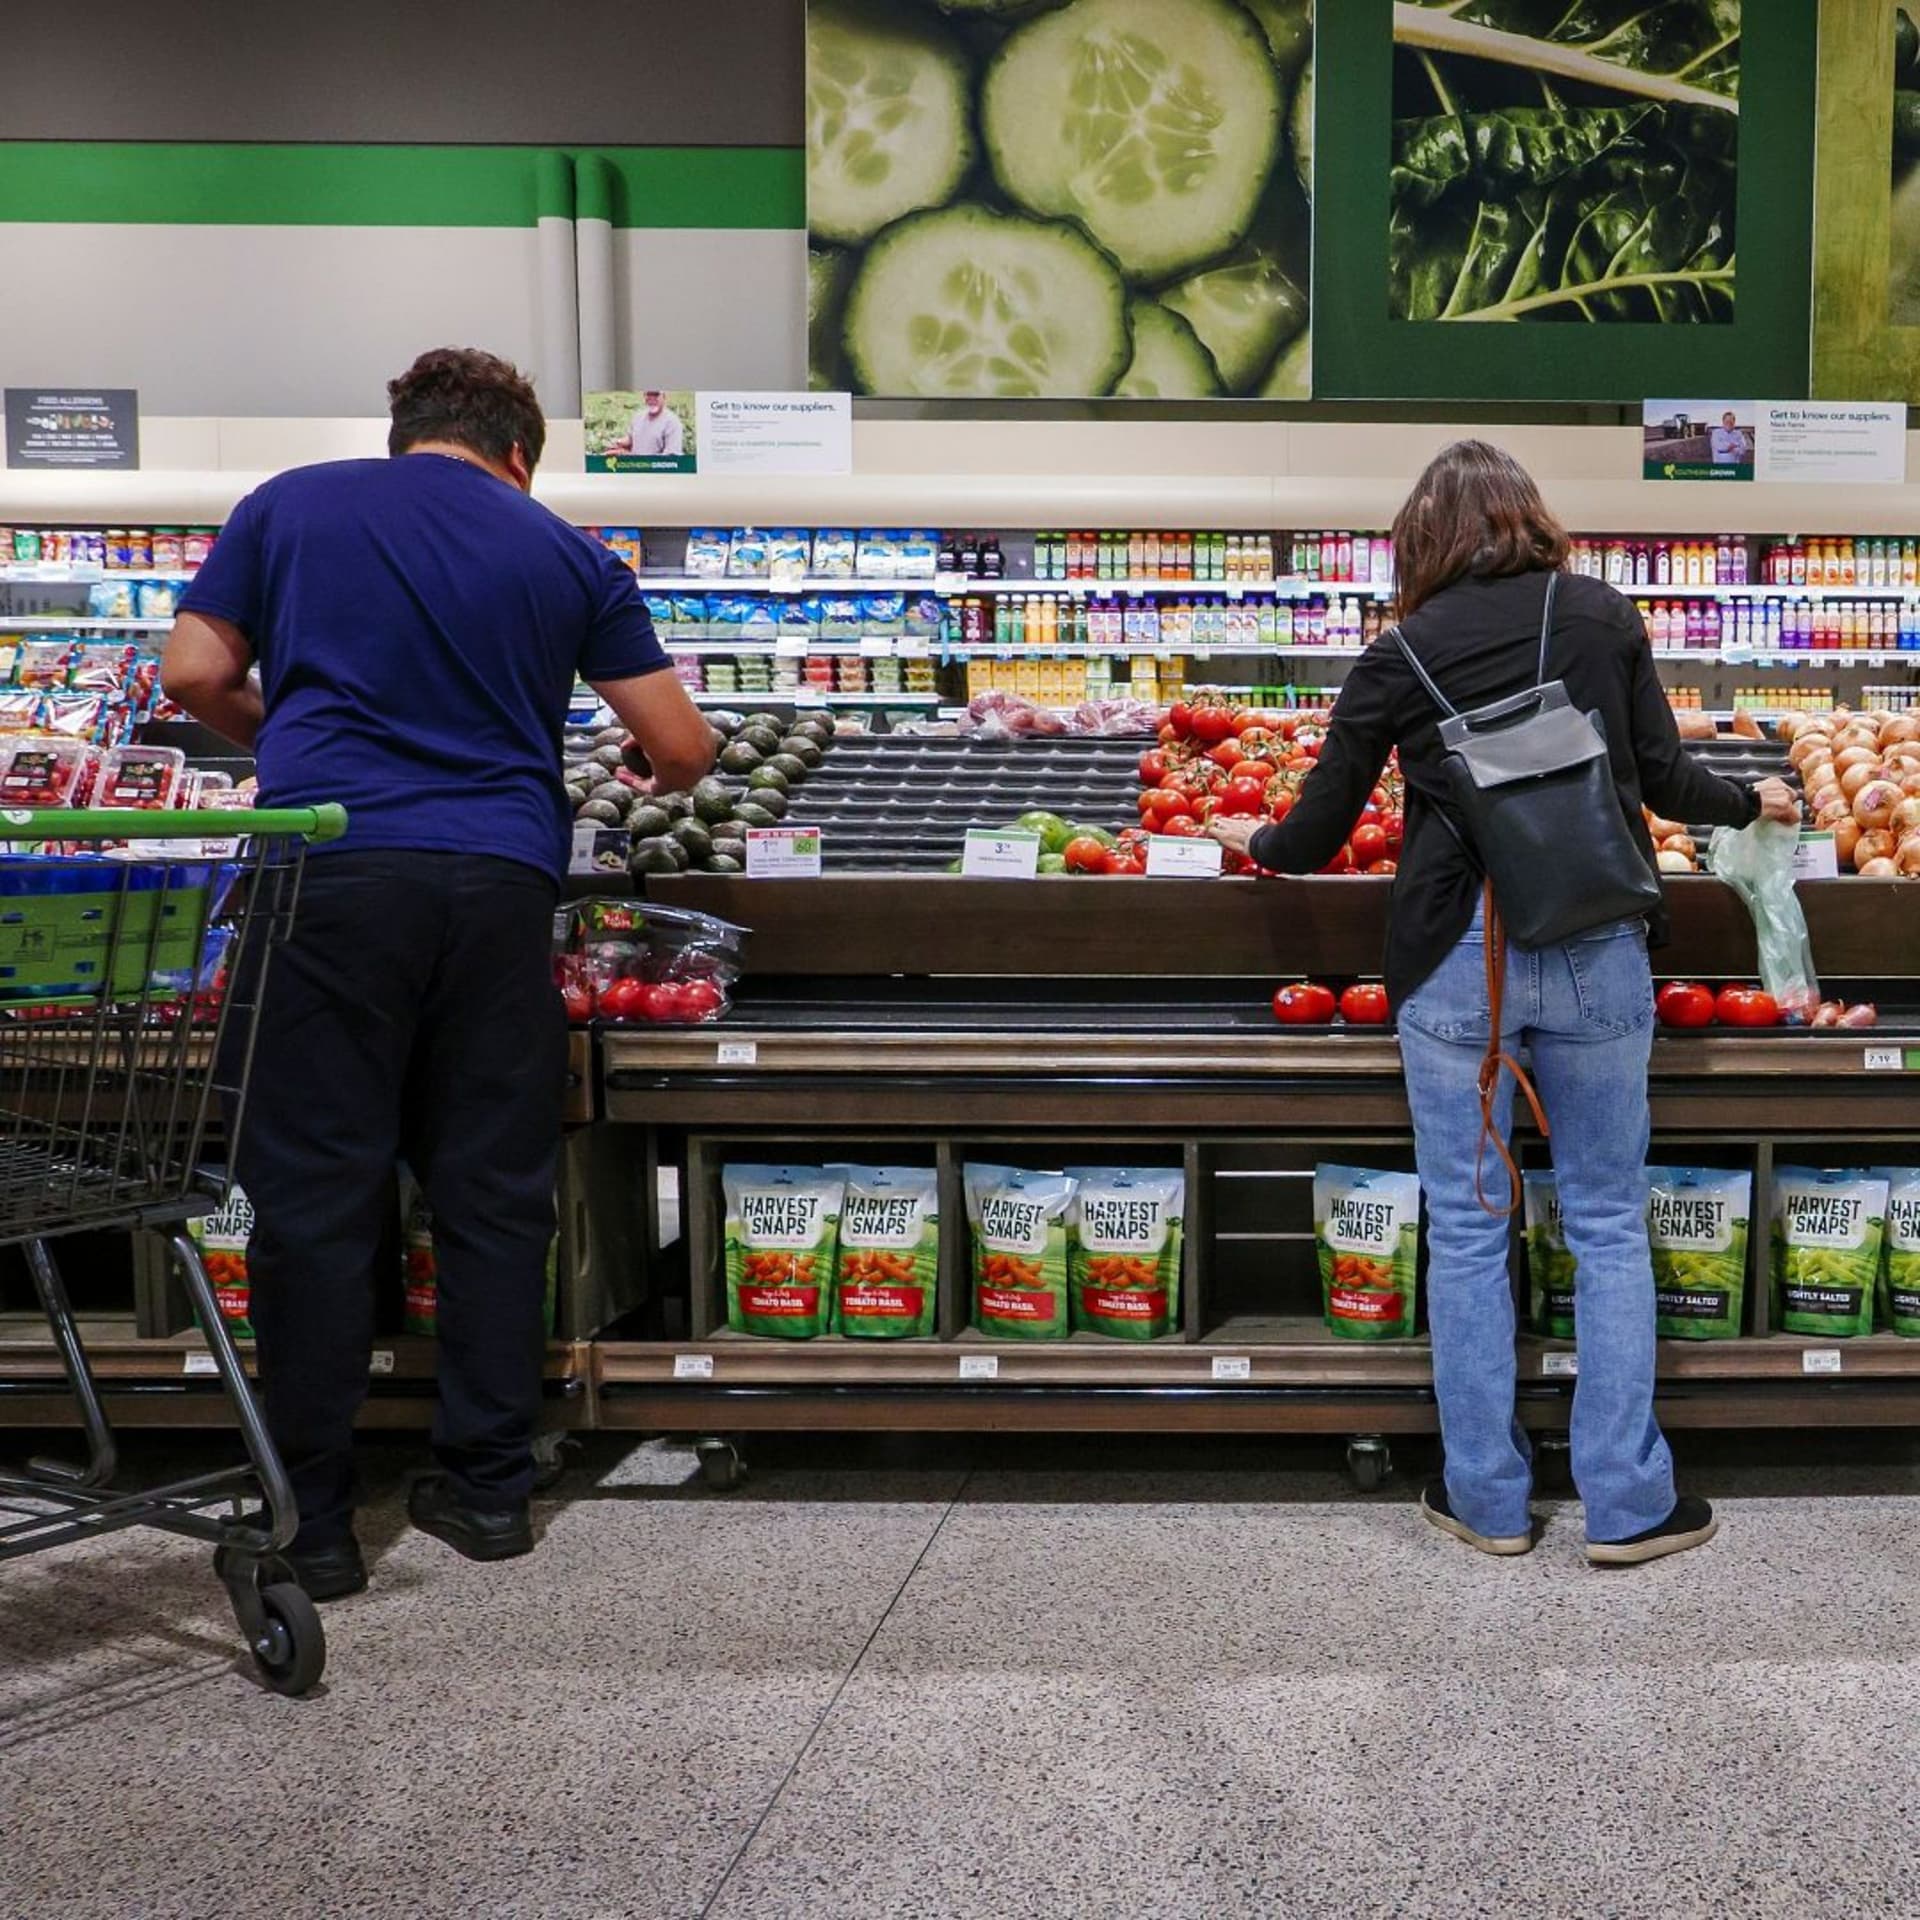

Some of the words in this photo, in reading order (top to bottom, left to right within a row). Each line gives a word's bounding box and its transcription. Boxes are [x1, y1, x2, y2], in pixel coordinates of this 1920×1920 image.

[710, 400, 729, 411] Get
[731, 402, 742, 411] to
[743, 400, 771, 411] know
[772, 403, 789, 411] our
[790, 401, 836, 413] suppliers.
[1769, 409, 1788, 420] Get
[1789, 411, 1800, 420] to
[1801, 409, 1829, 420] know
[1830, 412, 1846, 421] our
[743, 1197, 819, 1219] HARVEST
[846, 1196, 918, 1218] HARVEST
[982, 1197, 1044, 1225] HARVEST
[1085, 1201, 1160, 1222] HARVEST
[1331, 1199, 1394, 1226] HARVEST
[1650, 1198, 1725, 1222] HARVEST
[1787, 1196, 1862, 1220] HARVEST
[206, 1217, 252, 1237] SNAPS
[752, 1217, 806, 1235] SNAPS
[852, 1217, 906, 1235] SNAPS
[986, 1219, 1032, 1242] SNAPS
[1095, 1221, 1149, 1240] SNAPS
[1337, 1219, 1384, 1242] SNAPS
[1660, 1219, 1715, 1239] SNAPS
[1795, 1215, 1850, 1236] SNAPS
[1686, 1295, 1719, 1306] SALTED
[1820, 1292, 1851, 1302] SALTED
